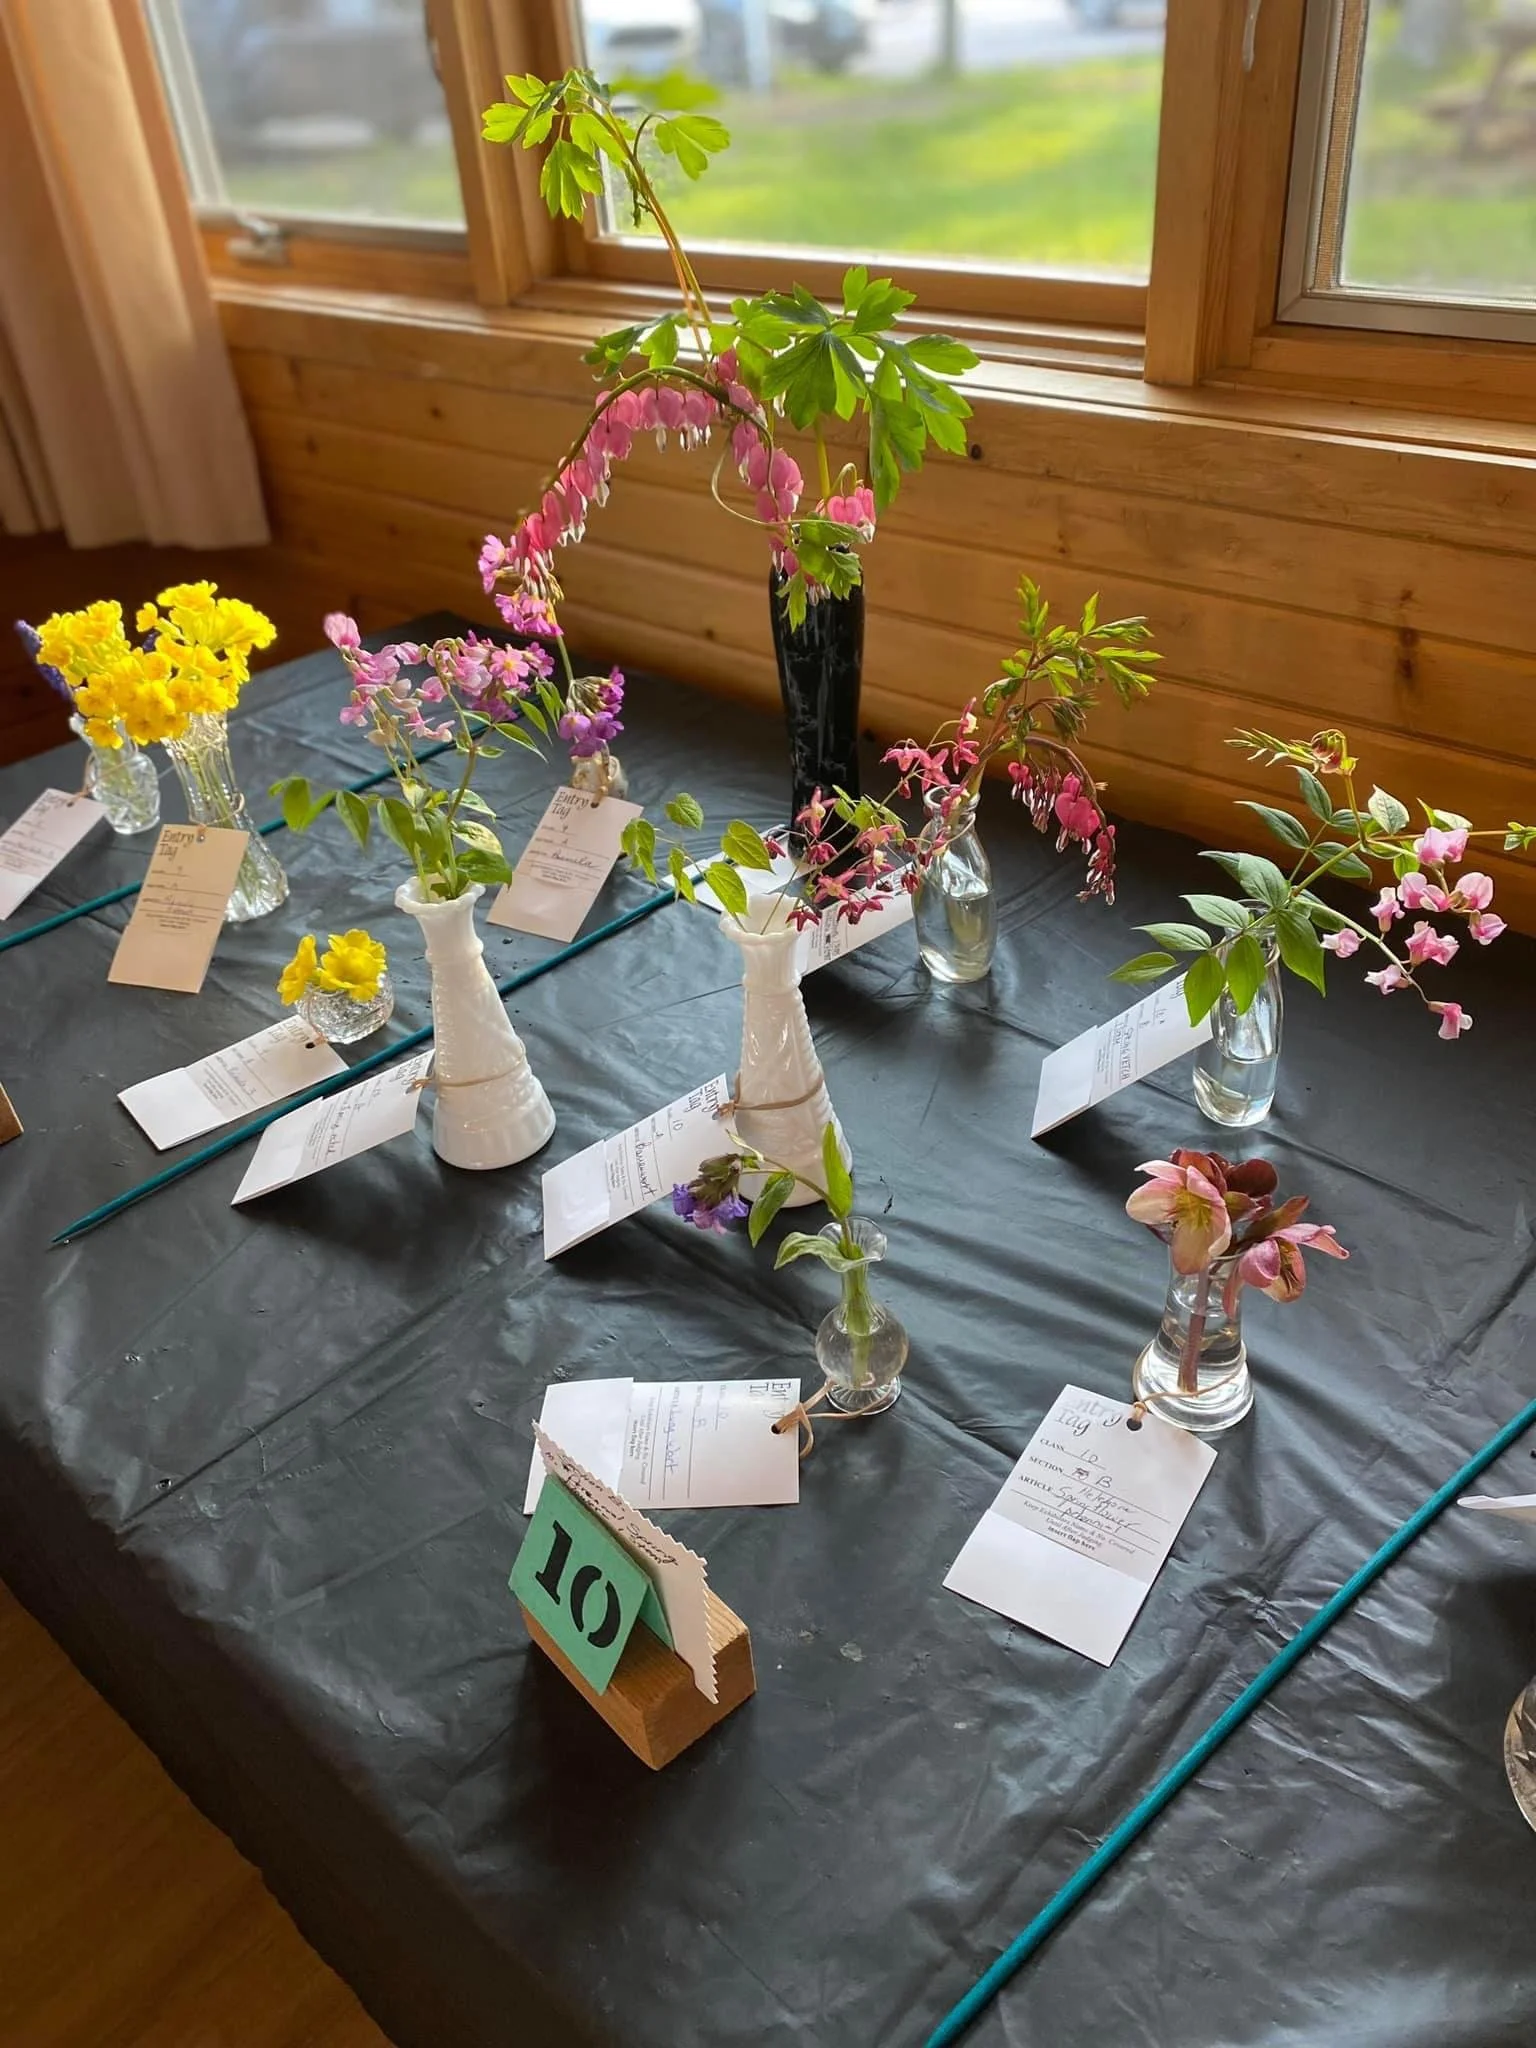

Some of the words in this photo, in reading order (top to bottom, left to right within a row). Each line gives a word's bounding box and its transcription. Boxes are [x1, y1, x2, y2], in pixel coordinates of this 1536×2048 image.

[551, 802, 571, 820] Tag
[556, 791, 590, 811] Entry
[161, 829, 195, 848] Entry
[158, 843, 179, 862] Tag
[683, 1087, 704, 1113] Tag
[701, 1080, 719, 1113] Entry
[672, 1119, 684, 1131] 10
[1055, 1407, 1091, 1437] Tag
[1040, 1437, 1065, 1453] CLASS
[1079, 1447, 1101, 1466] 10
[1029, 1455, 1064, 1475] SECTION
[1095, 1473, 1114, 1490] B
[1018, 1473, 1053, 1493] ARTICLE
[1066, 1534, 1081, 1545] flap
[1081, 1541, 1096, 1551] here
[535, 1519, 621, 1648] 10
